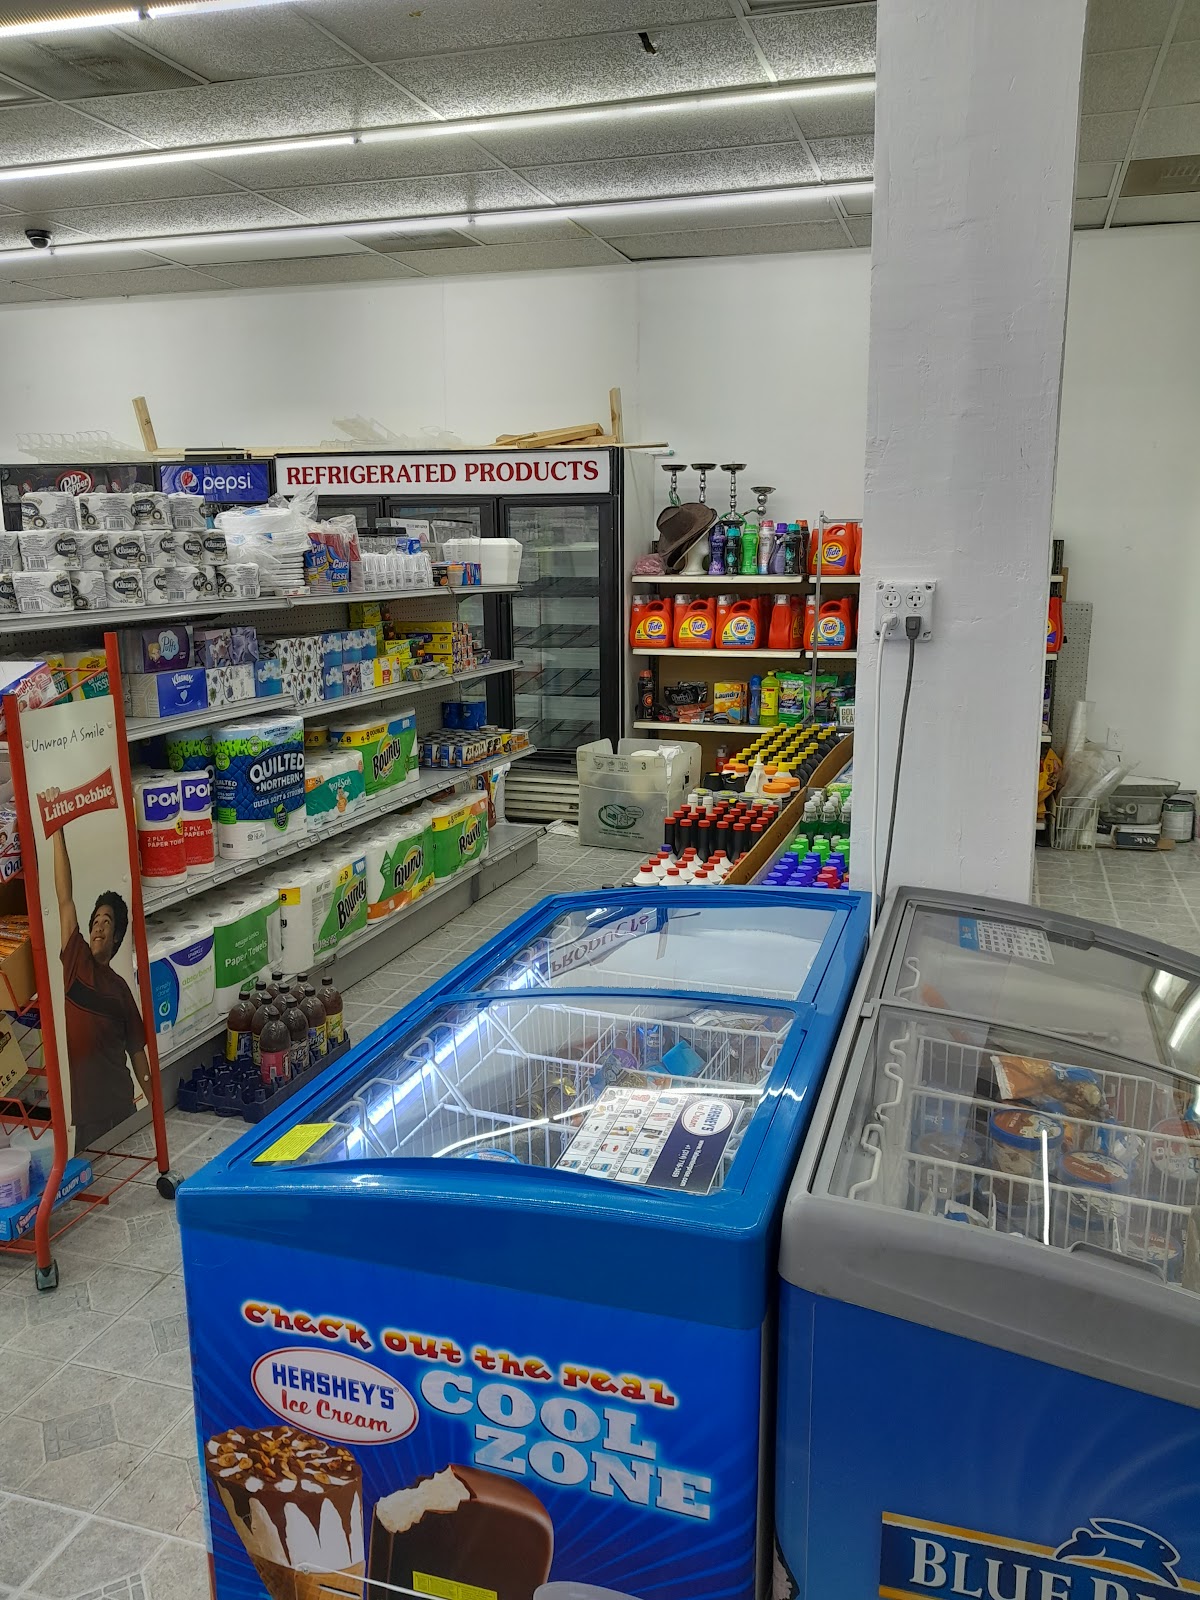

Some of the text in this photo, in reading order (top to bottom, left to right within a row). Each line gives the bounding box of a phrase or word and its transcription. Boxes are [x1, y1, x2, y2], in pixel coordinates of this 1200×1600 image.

[70, 474, 81, 484] Dr
[286, 460, 599, 485] REFRIGERATED PRODUCTS
[63, 477, 89, 496] Pepper
[203, 473, 251, 494] pepsi
[826, 547, 841, 558] Tide
[648, 620, 663, 631] Tide
[692, 620, 706, 631] Tide
[734, 620, 749, 631] Tide
[822, 623, 838, 633] Tide
[160, 636, 177, 653] Puffs
[171, 673, 194, 687] Kleenex
[714, 691, 740, 699] Laundry
[841, 715, 855, 723] PEA
[31, 723, 105, 753] Unwrap A Smile
[249, 753, 305, 784] QUILTED
[372, 738, 401, 782] Bounty
[641, 761, 647, 771] 3
[260, 772, 300, 793] NORTHERN
[43, 784, 113, 822] Little Debbie
[253, 798, 270, 809] ULTRA
[394, 850, 424, 889] ounty
[225, 939, 268, 968] Paper Towels
[383, 1330, 462, 1363] out
[474, 1347, 551, 1380] the
[271, 1361, 394, 1411] HERSHEY'S
[281, 1390, 393, 1434] Ice Cream
[420, 1369, 657, 1459] COOL
[474, 1425, 712, 1521] ZONE
[909, 1536, 1072, 1600] BLUE
